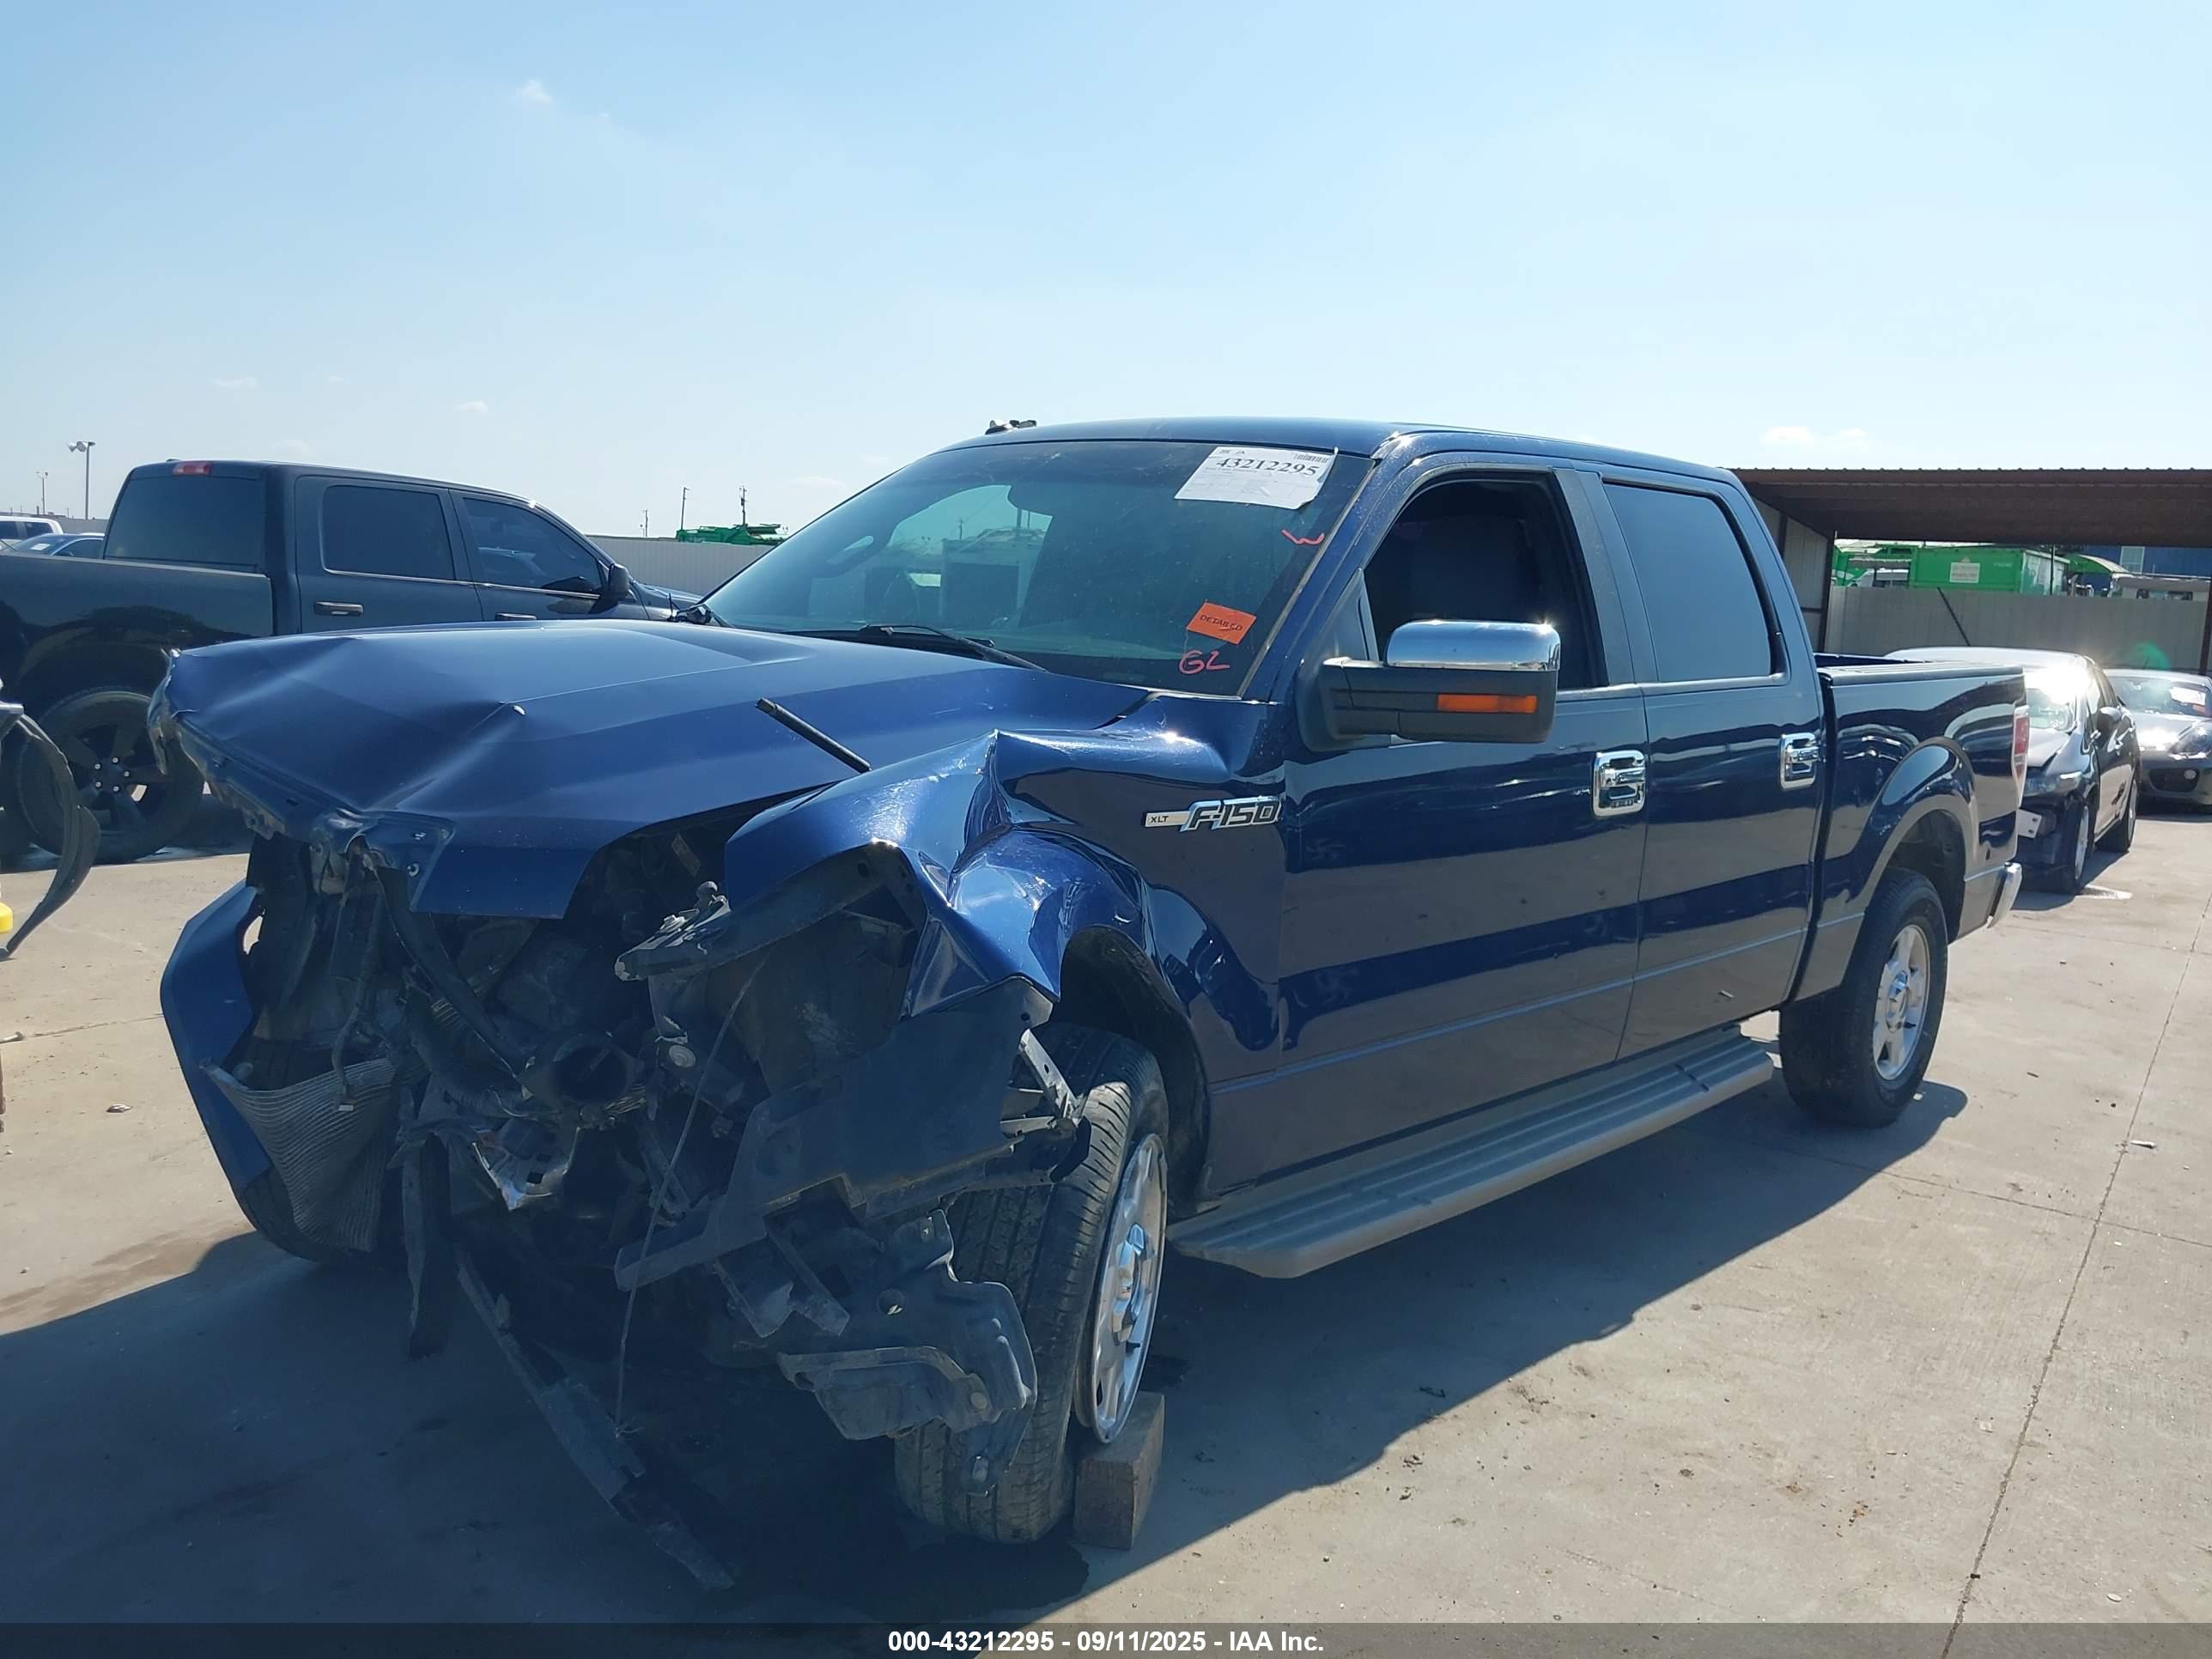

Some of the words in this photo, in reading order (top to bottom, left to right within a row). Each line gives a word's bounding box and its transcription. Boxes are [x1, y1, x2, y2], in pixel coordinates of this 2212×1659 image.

[1216, 457, 1321, 476] 43212295
[1150, 815, 1170, 823] XLT
[1180, 795, 1282, 832] F-150
